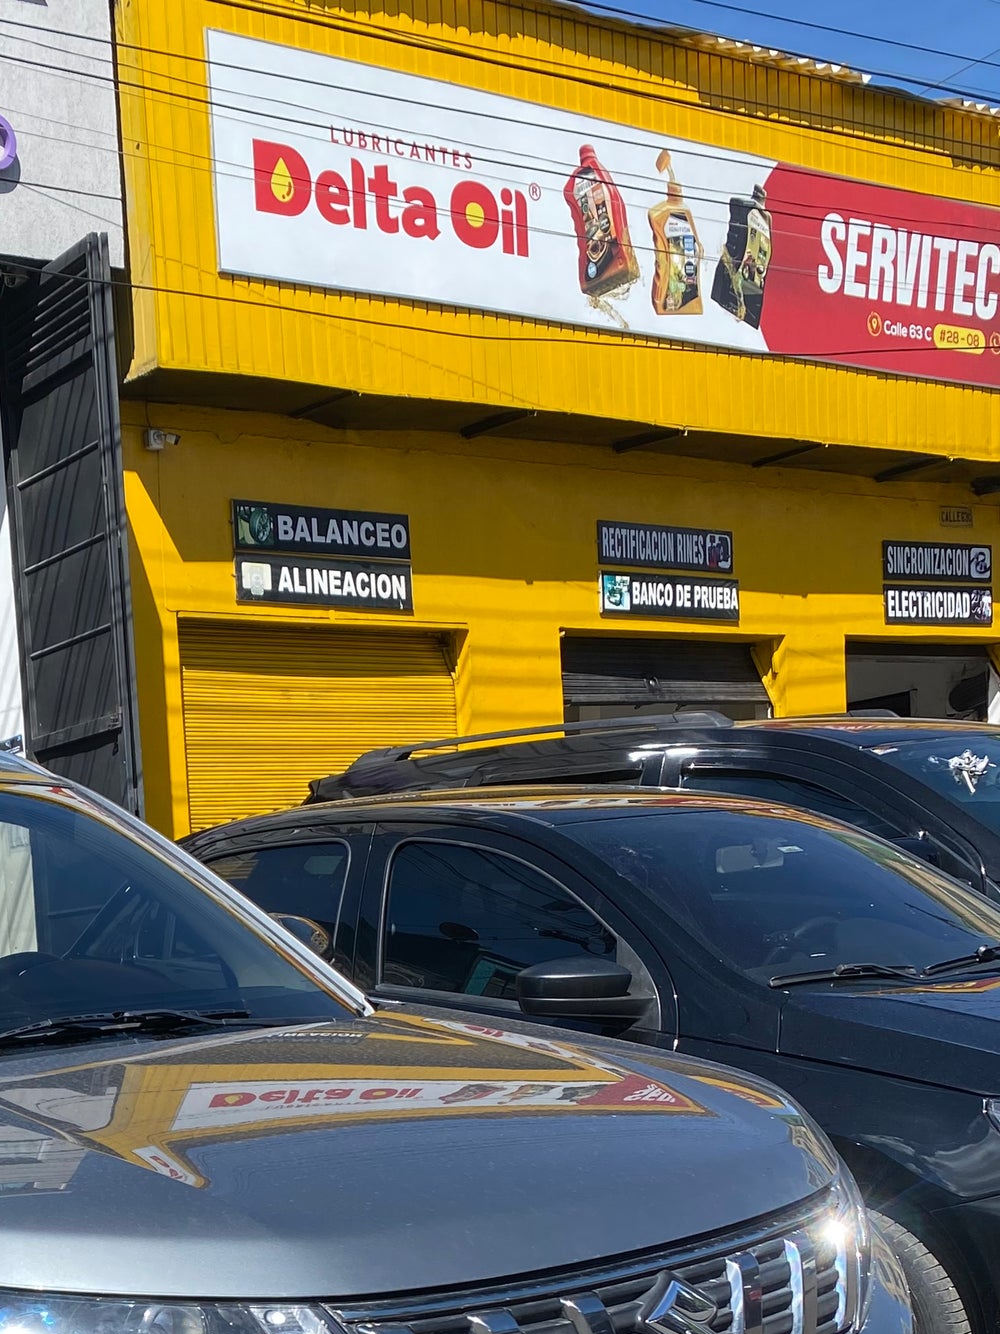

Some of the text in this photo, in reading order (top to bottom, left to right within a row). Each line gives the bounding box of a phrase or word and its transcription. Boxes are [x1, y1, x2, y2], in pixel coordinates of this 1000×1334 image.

[330, 125, 473, 169] LUBRICANTES
[252, 138, 441, 241] Delta
[883, 320, 908, 336] Calle
[909, 324, 923, 339] 63
[924, 328, 932, 341] C
[277, 515, 407, 549] BALANCEO
[602, 527, 704, 565] RECTIFICACION RINES
[887, 545, 969, 576] SINCRONIZACION
[278, 566, 407, 600] ALINEACION
[632, 582, 739, 610] BANCO DE PRUEBA
[887, 590, 970, 618] ELECTRICIDAD
